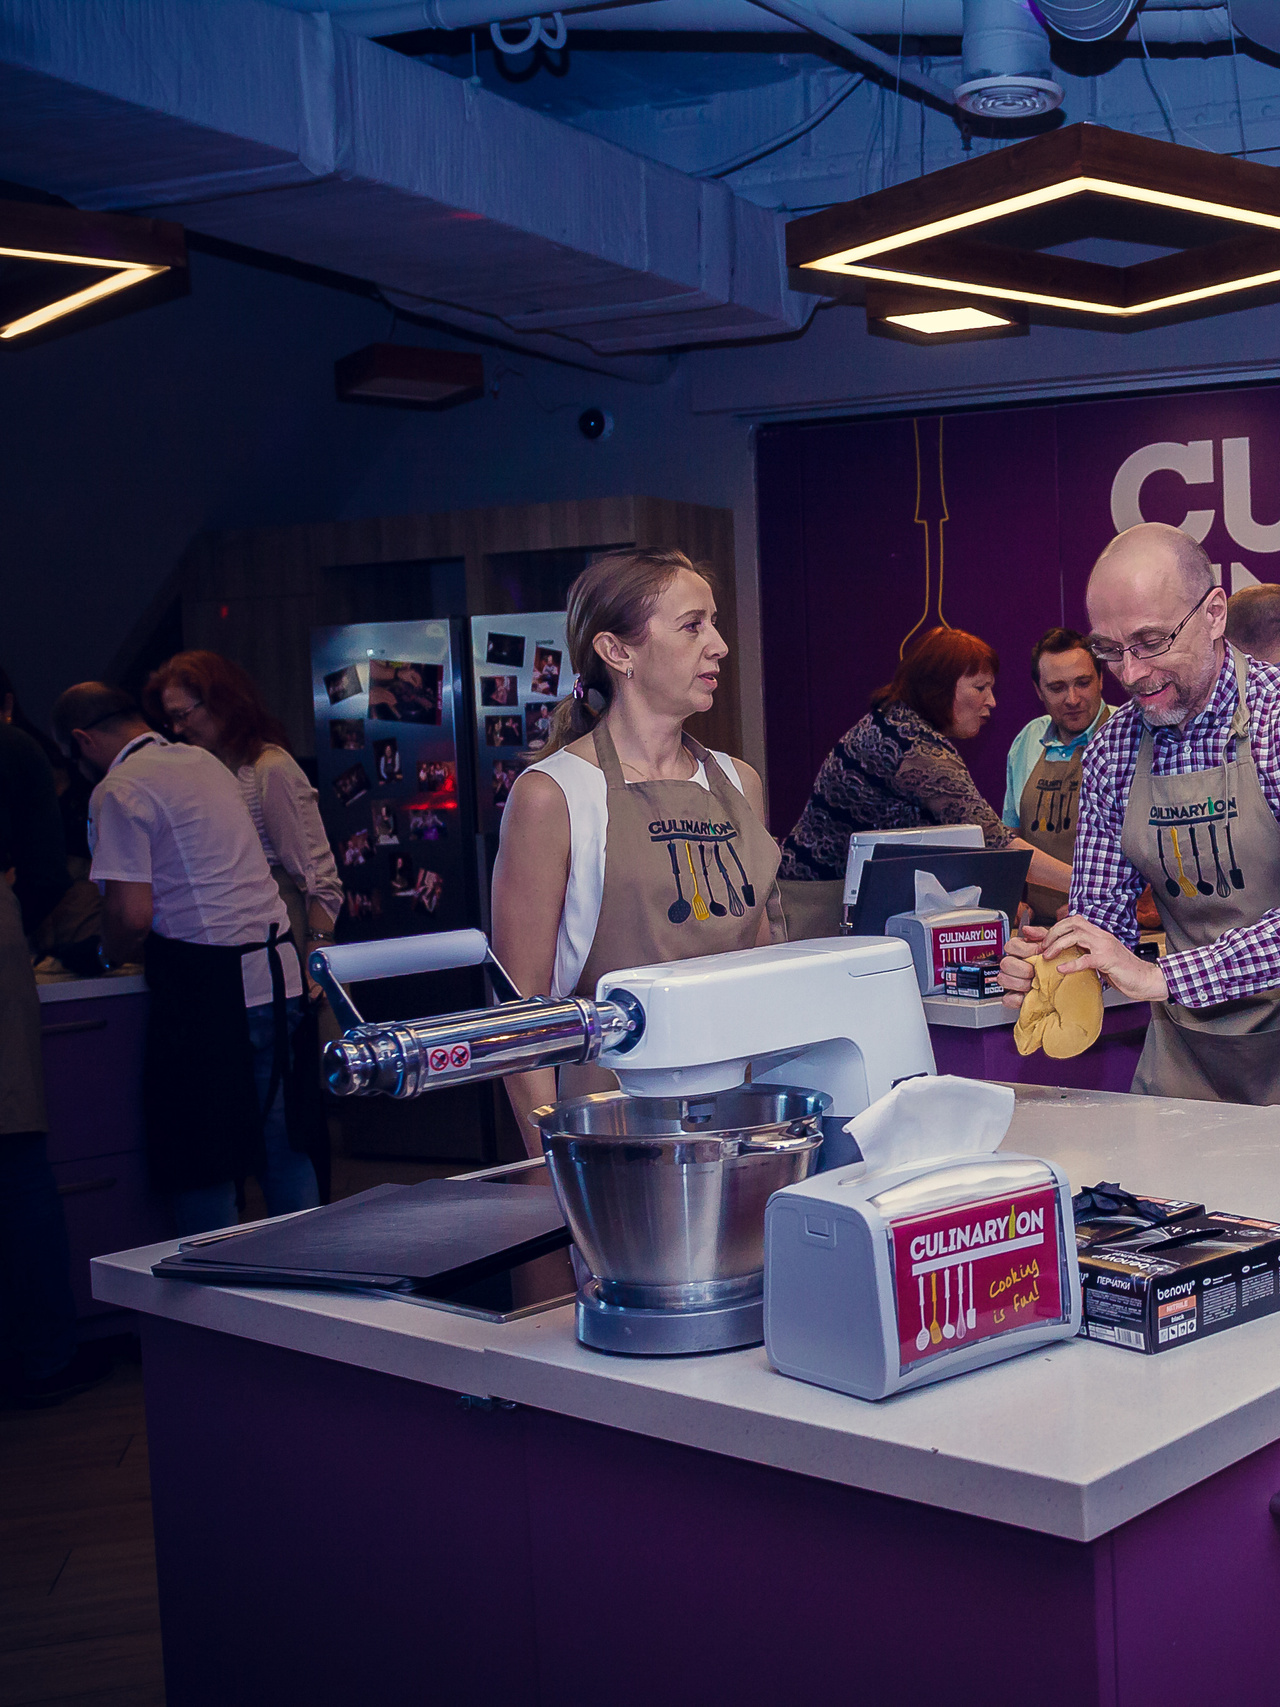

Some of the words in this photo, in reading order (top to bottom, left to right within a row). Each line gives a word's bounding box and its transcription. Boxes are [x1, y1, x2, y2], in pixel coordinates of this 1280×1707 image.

[1096, 1275, 1131, 1291] ПЕРЧАТКИ
[993, 1308, 1006, 1324] is
[1171, 1314, 1185, 1323] black
